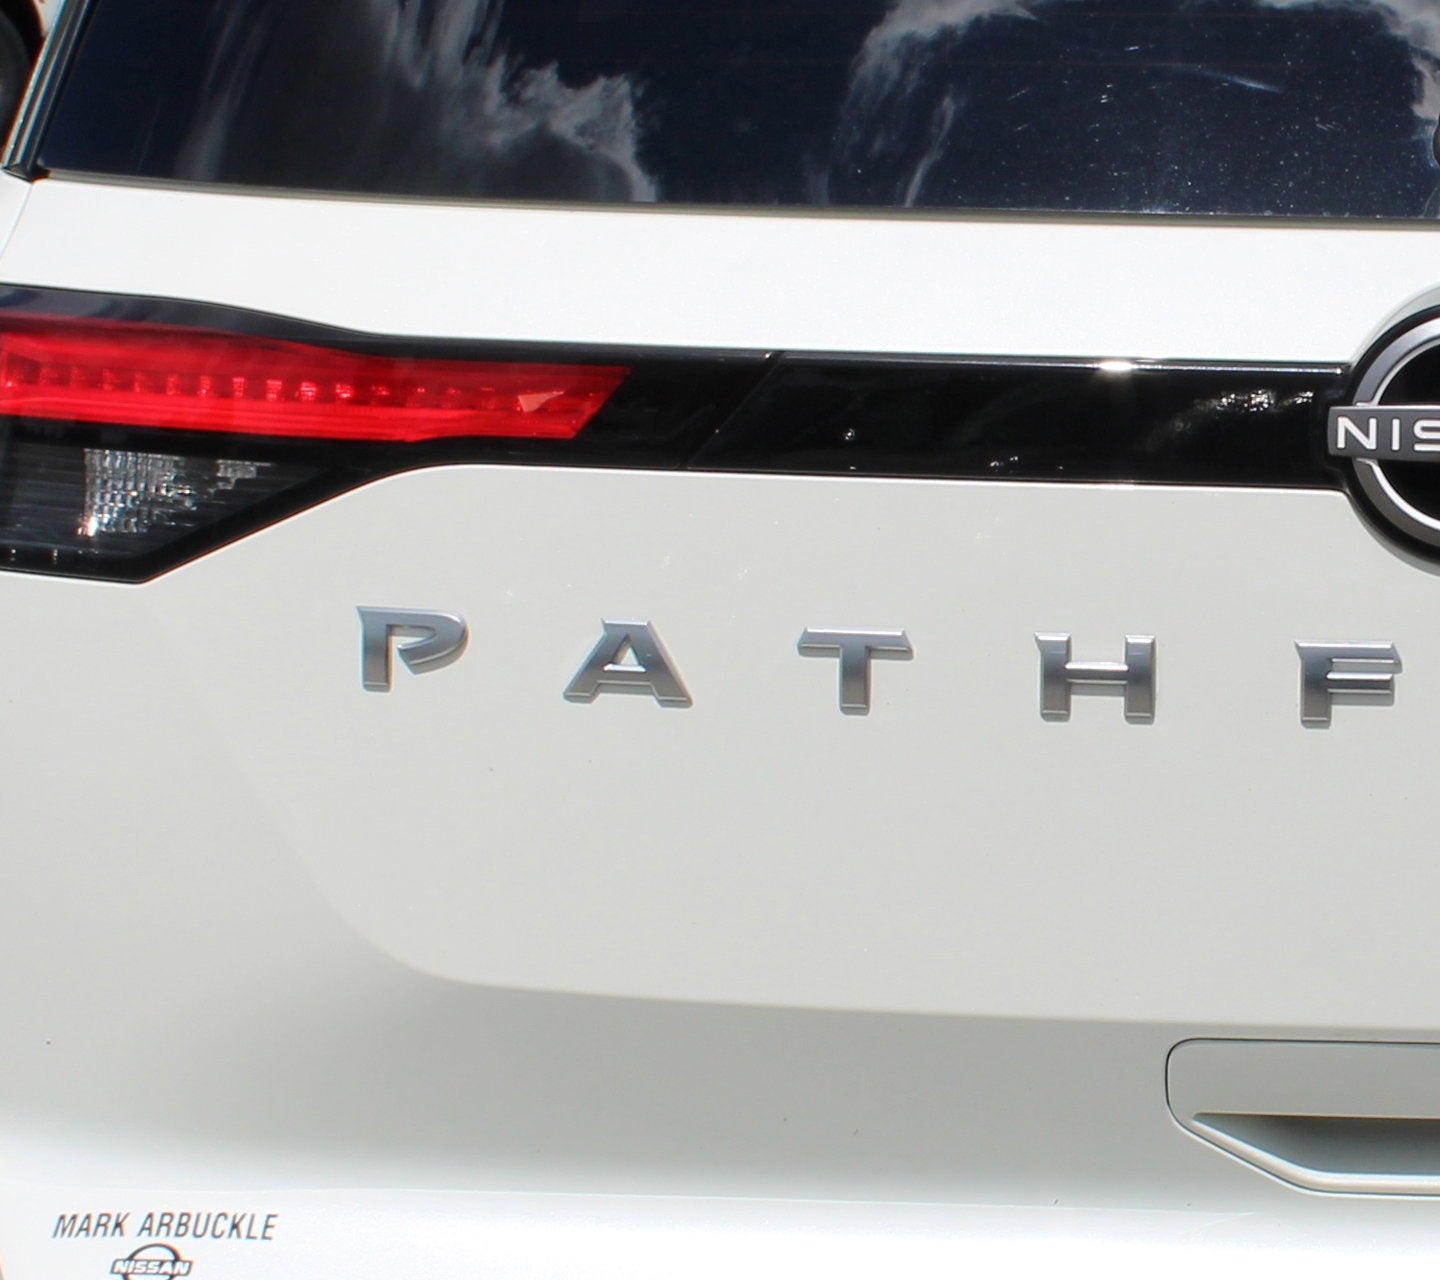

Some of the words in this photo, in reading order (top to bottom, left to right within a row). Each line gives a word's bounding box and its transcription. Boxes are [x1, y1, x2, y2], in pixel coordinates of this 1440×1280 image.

[52, 1212, 130, 1239] MARK
[136, 1211, 278, 1242] ARBUCKLE
[113, 1258, 190, 1276] NISSAN
